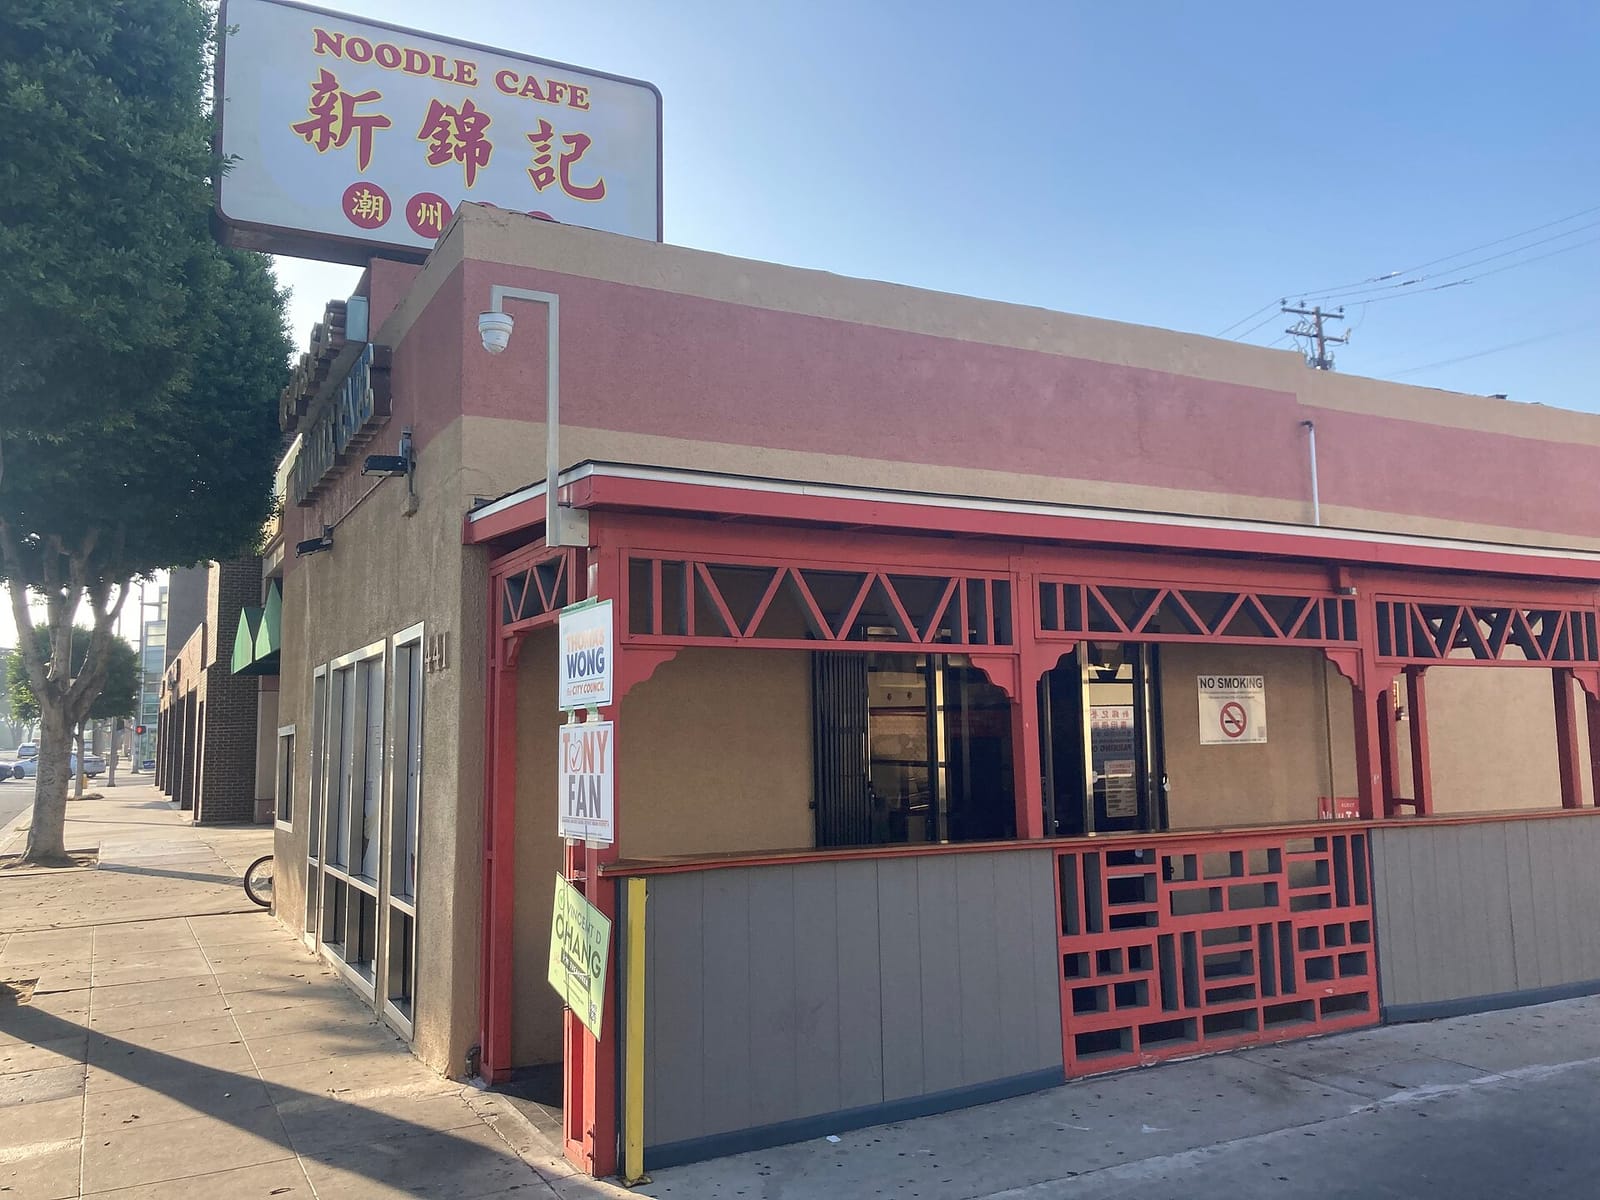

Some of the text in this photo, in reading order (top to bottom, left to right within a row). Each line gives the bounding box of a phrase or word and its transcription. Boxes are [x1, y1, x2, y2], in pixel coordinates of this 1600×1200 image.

[312, 28, 591, 111] NOODLE CAFE
[291, 68, 606, 201] 新錦記
[425, 631, 447, 672] 441
[566, 646, 605, 679] WONG
[1200, 677, 1263, 689] NO SMOKING
[568, 775, 602, 818] FAN
[556, 913, 602, 979] CHANG
